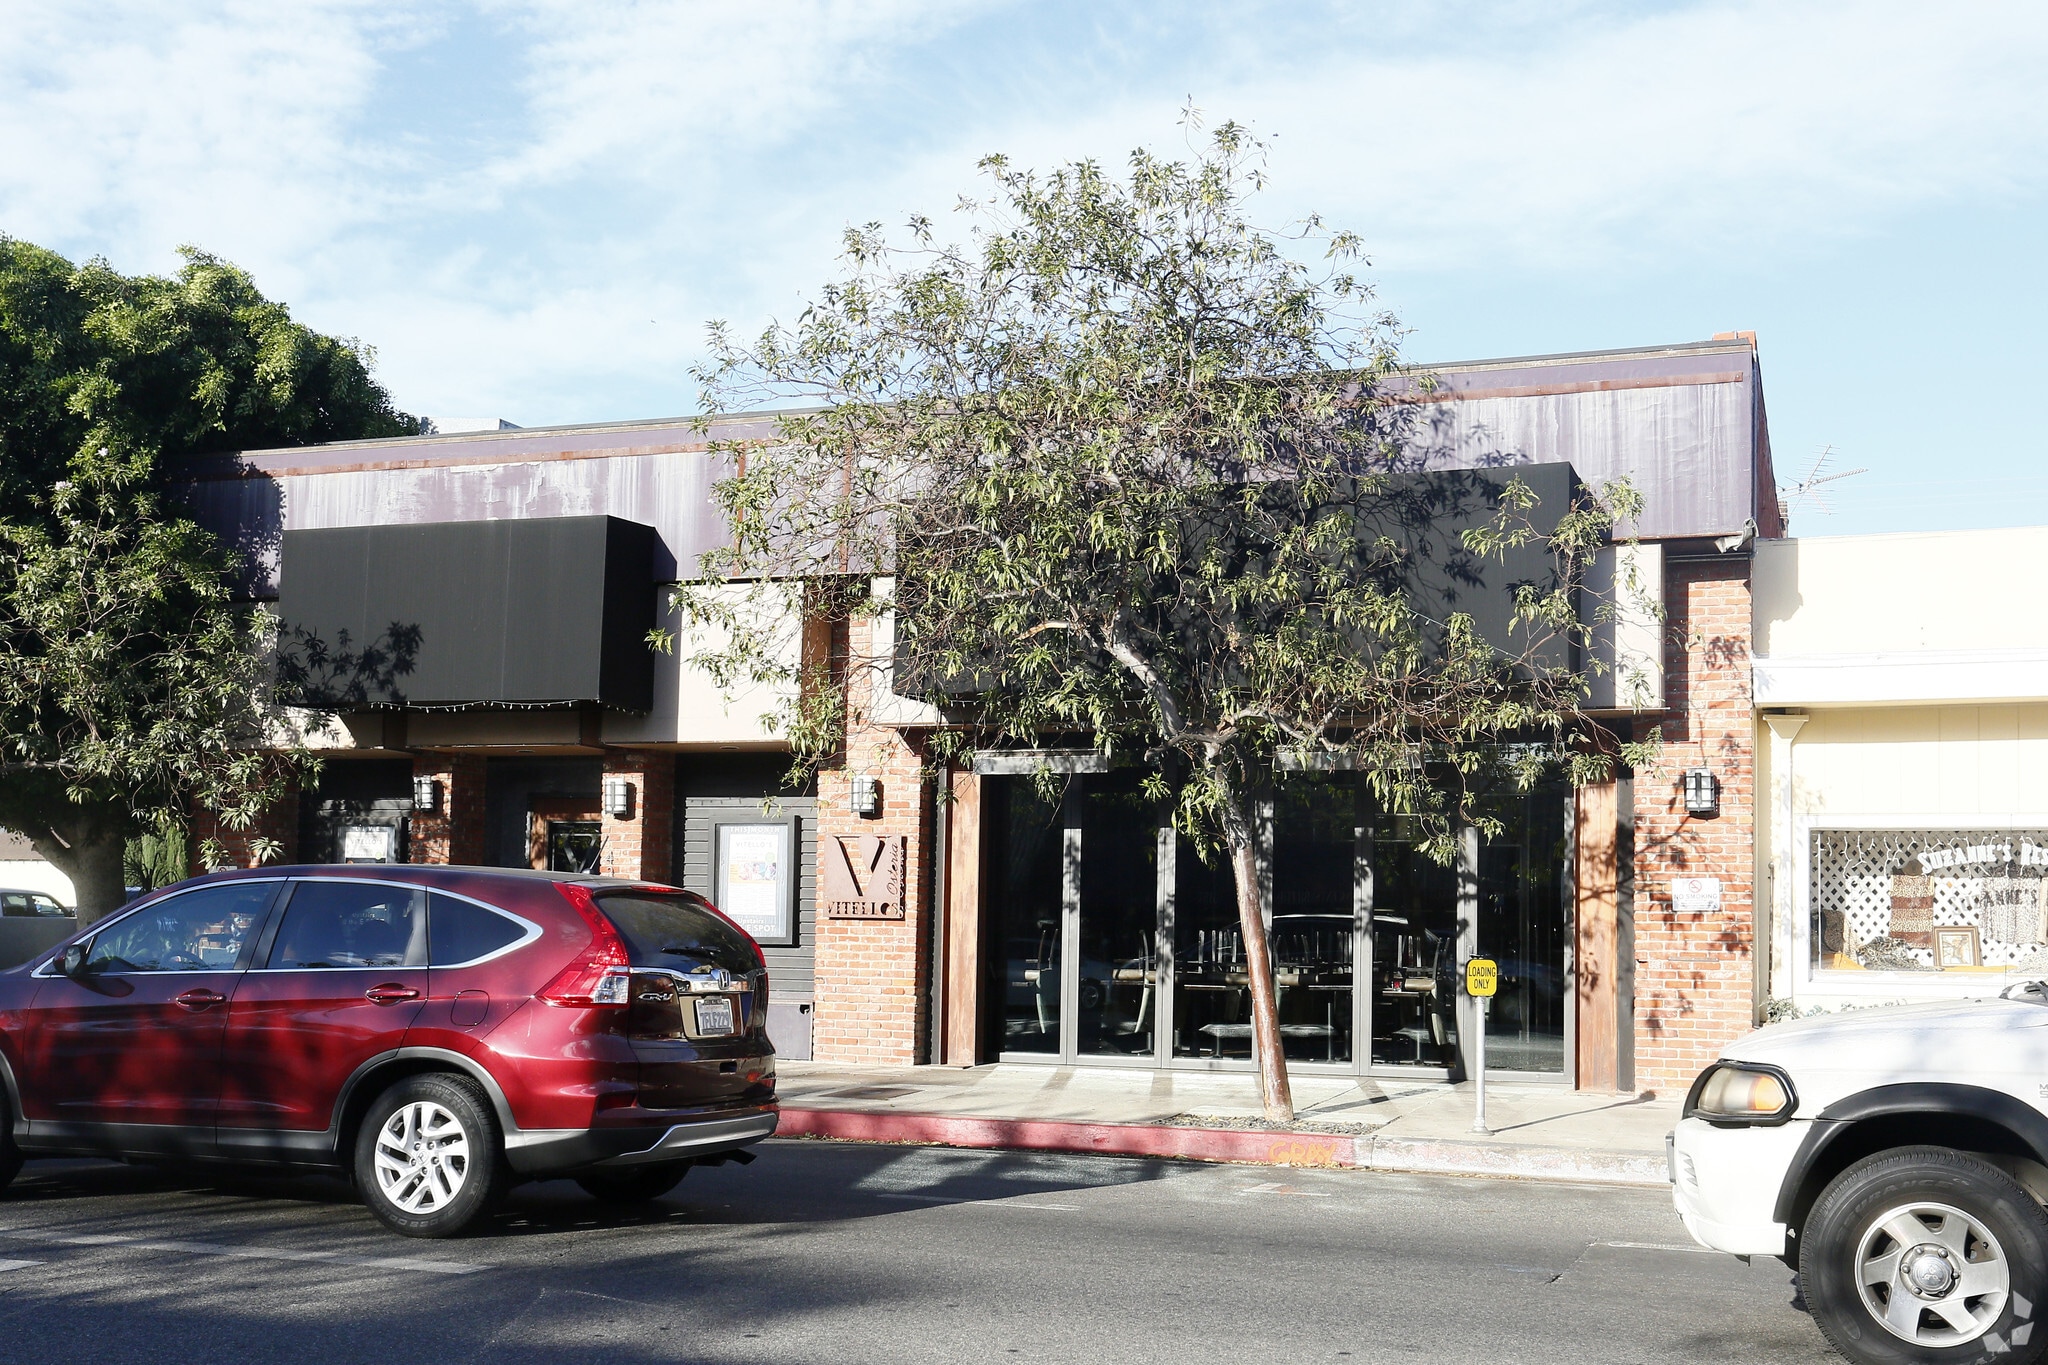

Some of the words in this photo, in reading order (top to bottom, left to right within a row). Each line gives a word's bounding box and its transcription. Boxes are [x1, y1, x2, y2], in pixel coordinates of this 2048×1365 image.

[832, 835, 892, 897] V
[887, 842, 899, 895] Osteria
[753, 924, 776, 932] SPOT
[1468, 966, 1496, 977] LOADING
[1473, 979, 1490, 989] ONLY
